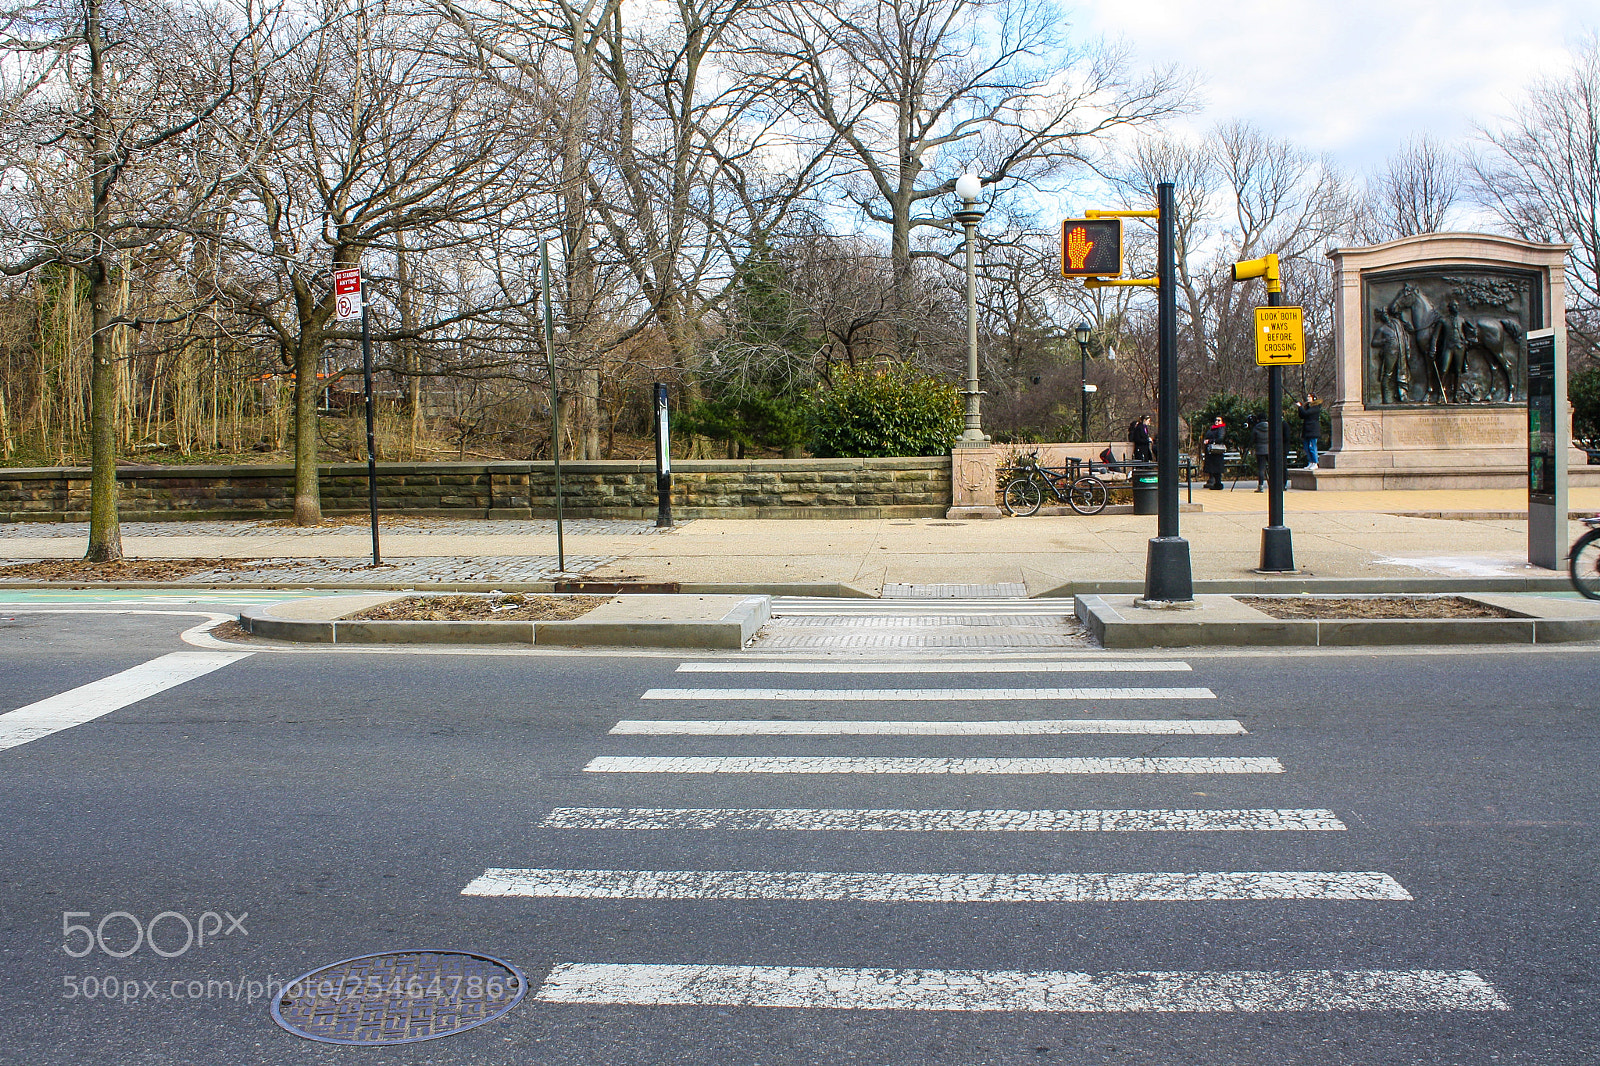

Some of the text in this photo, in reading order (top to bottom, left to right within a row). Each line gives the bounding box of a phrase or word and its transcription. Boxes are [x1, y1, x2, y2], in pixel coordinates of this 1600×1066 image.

[1260, 312, 1298, 321] LOOK BOTH
[1270, 322, 1289, 331] WAYS
[1267, 332, 1292, 342] BEFORE
[1264, 342, 1297, 352] CROSSING
